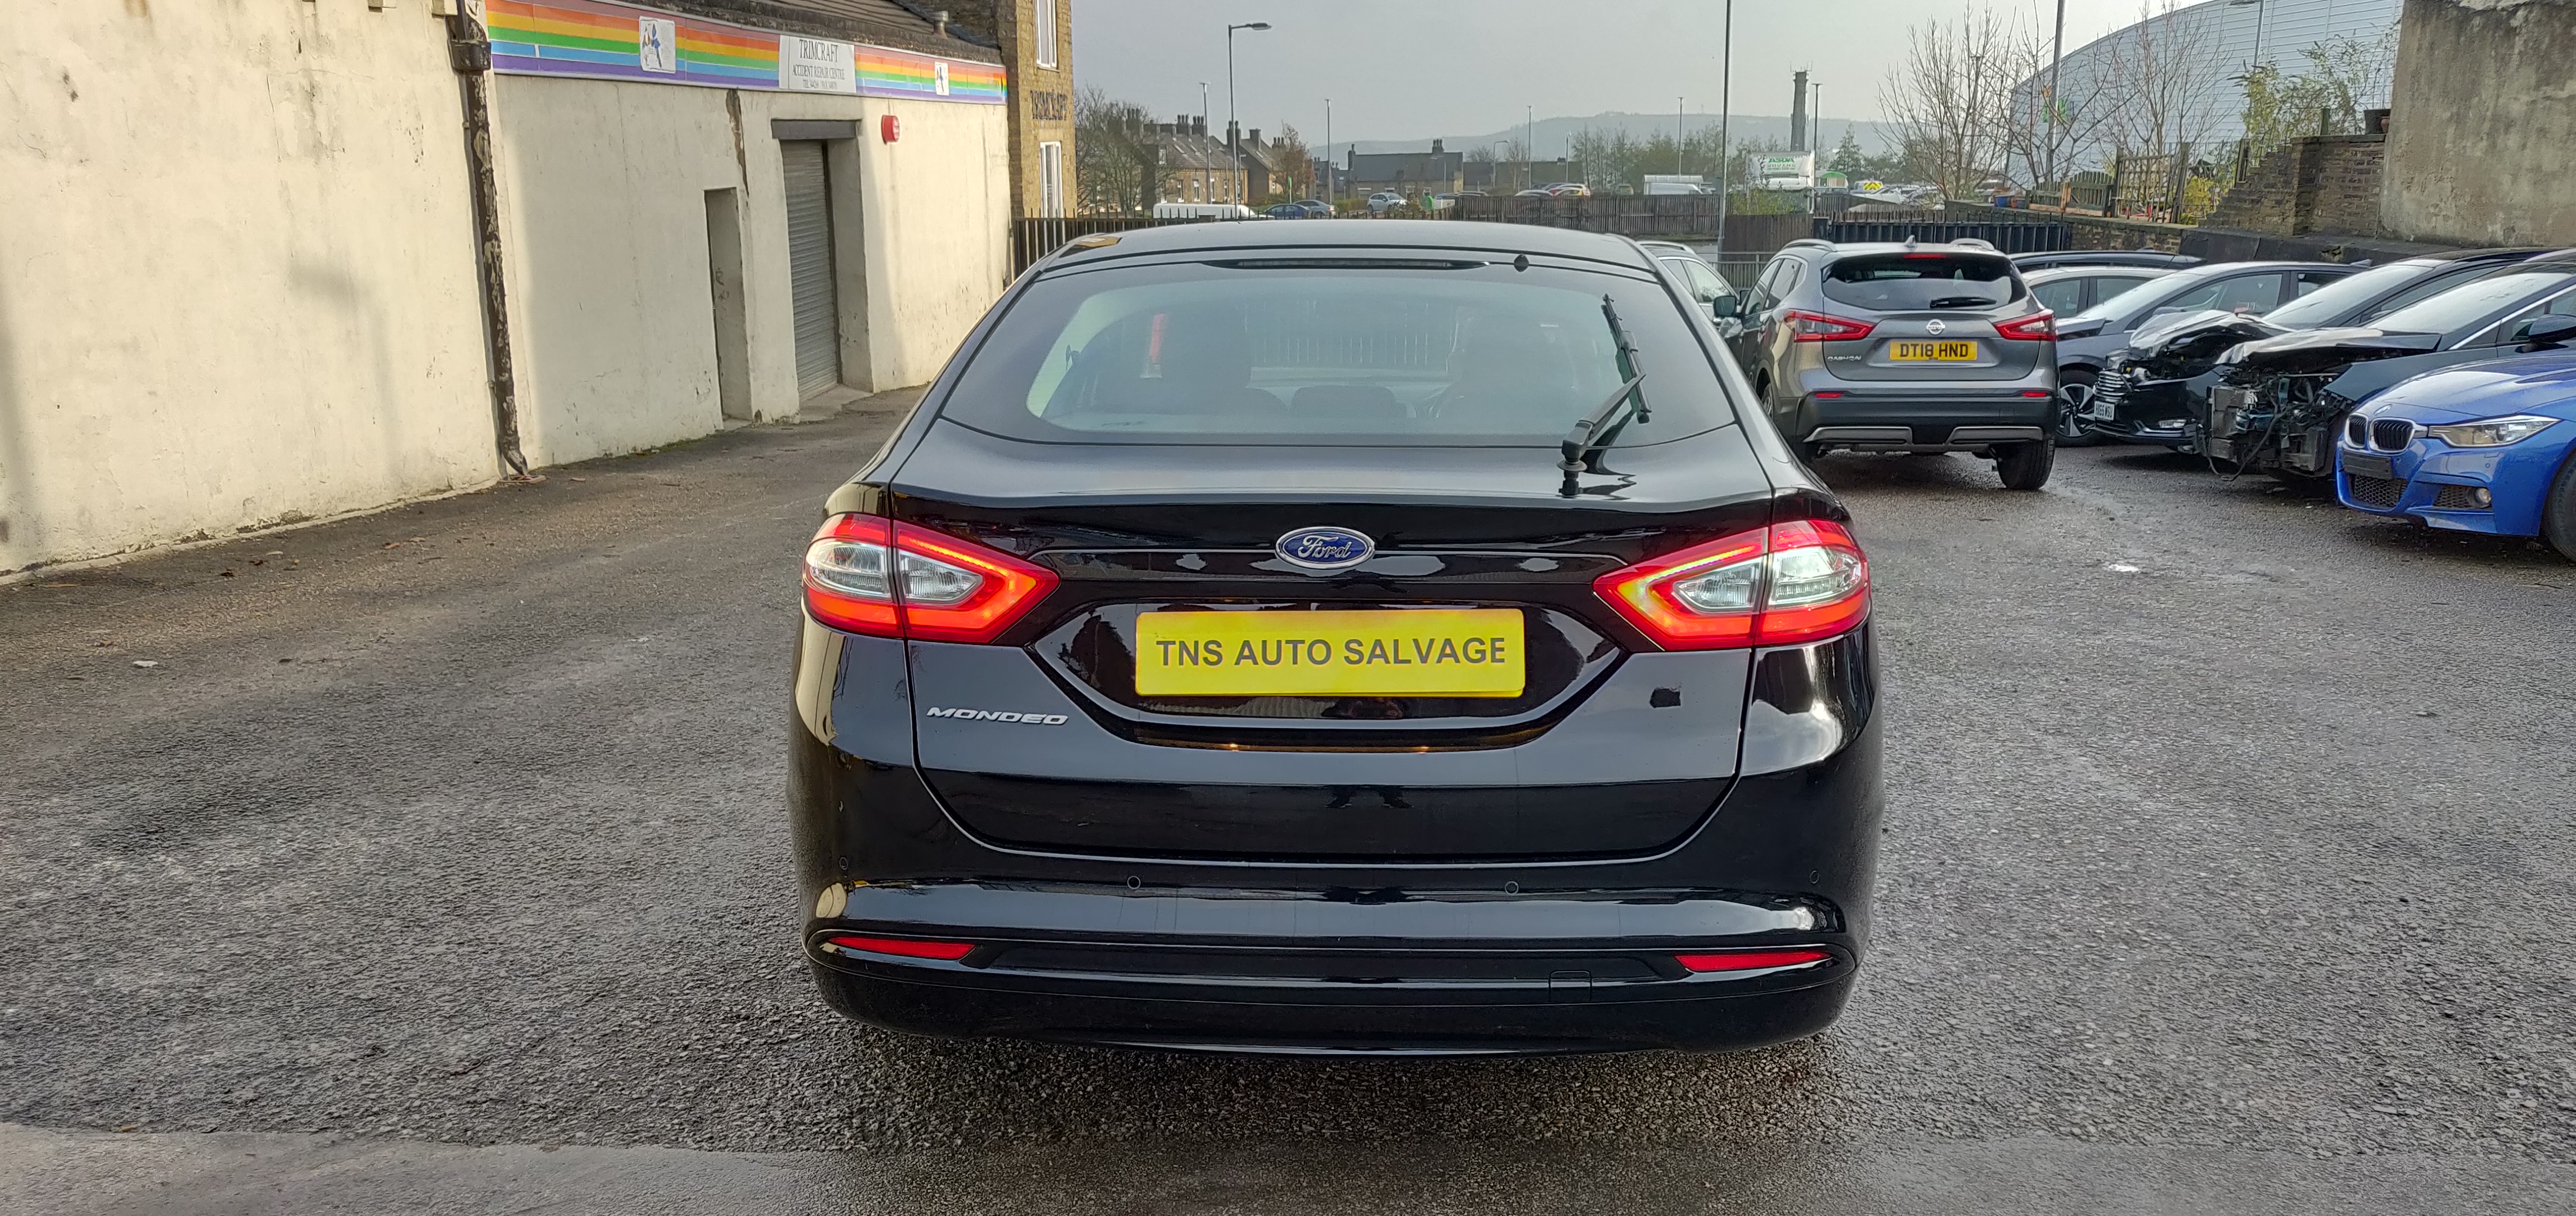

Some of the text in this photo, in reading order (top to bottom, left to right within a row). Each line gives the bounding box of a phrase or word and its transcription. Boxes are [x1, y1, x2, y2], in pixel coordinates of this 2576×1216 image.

[799, 39, 838, 62] TRIMCRAFT
[793, 64, 845, 79] ACCIDENT REPAIR CENTRE
[1900, 344, 1968, 357] DT18 HND
[1298, 535, 1353, 559] Ford
[1156, 637, 1505, 666] TNS AUTO SALVAGE
[926, 707, 1068, 725] MONDEO
